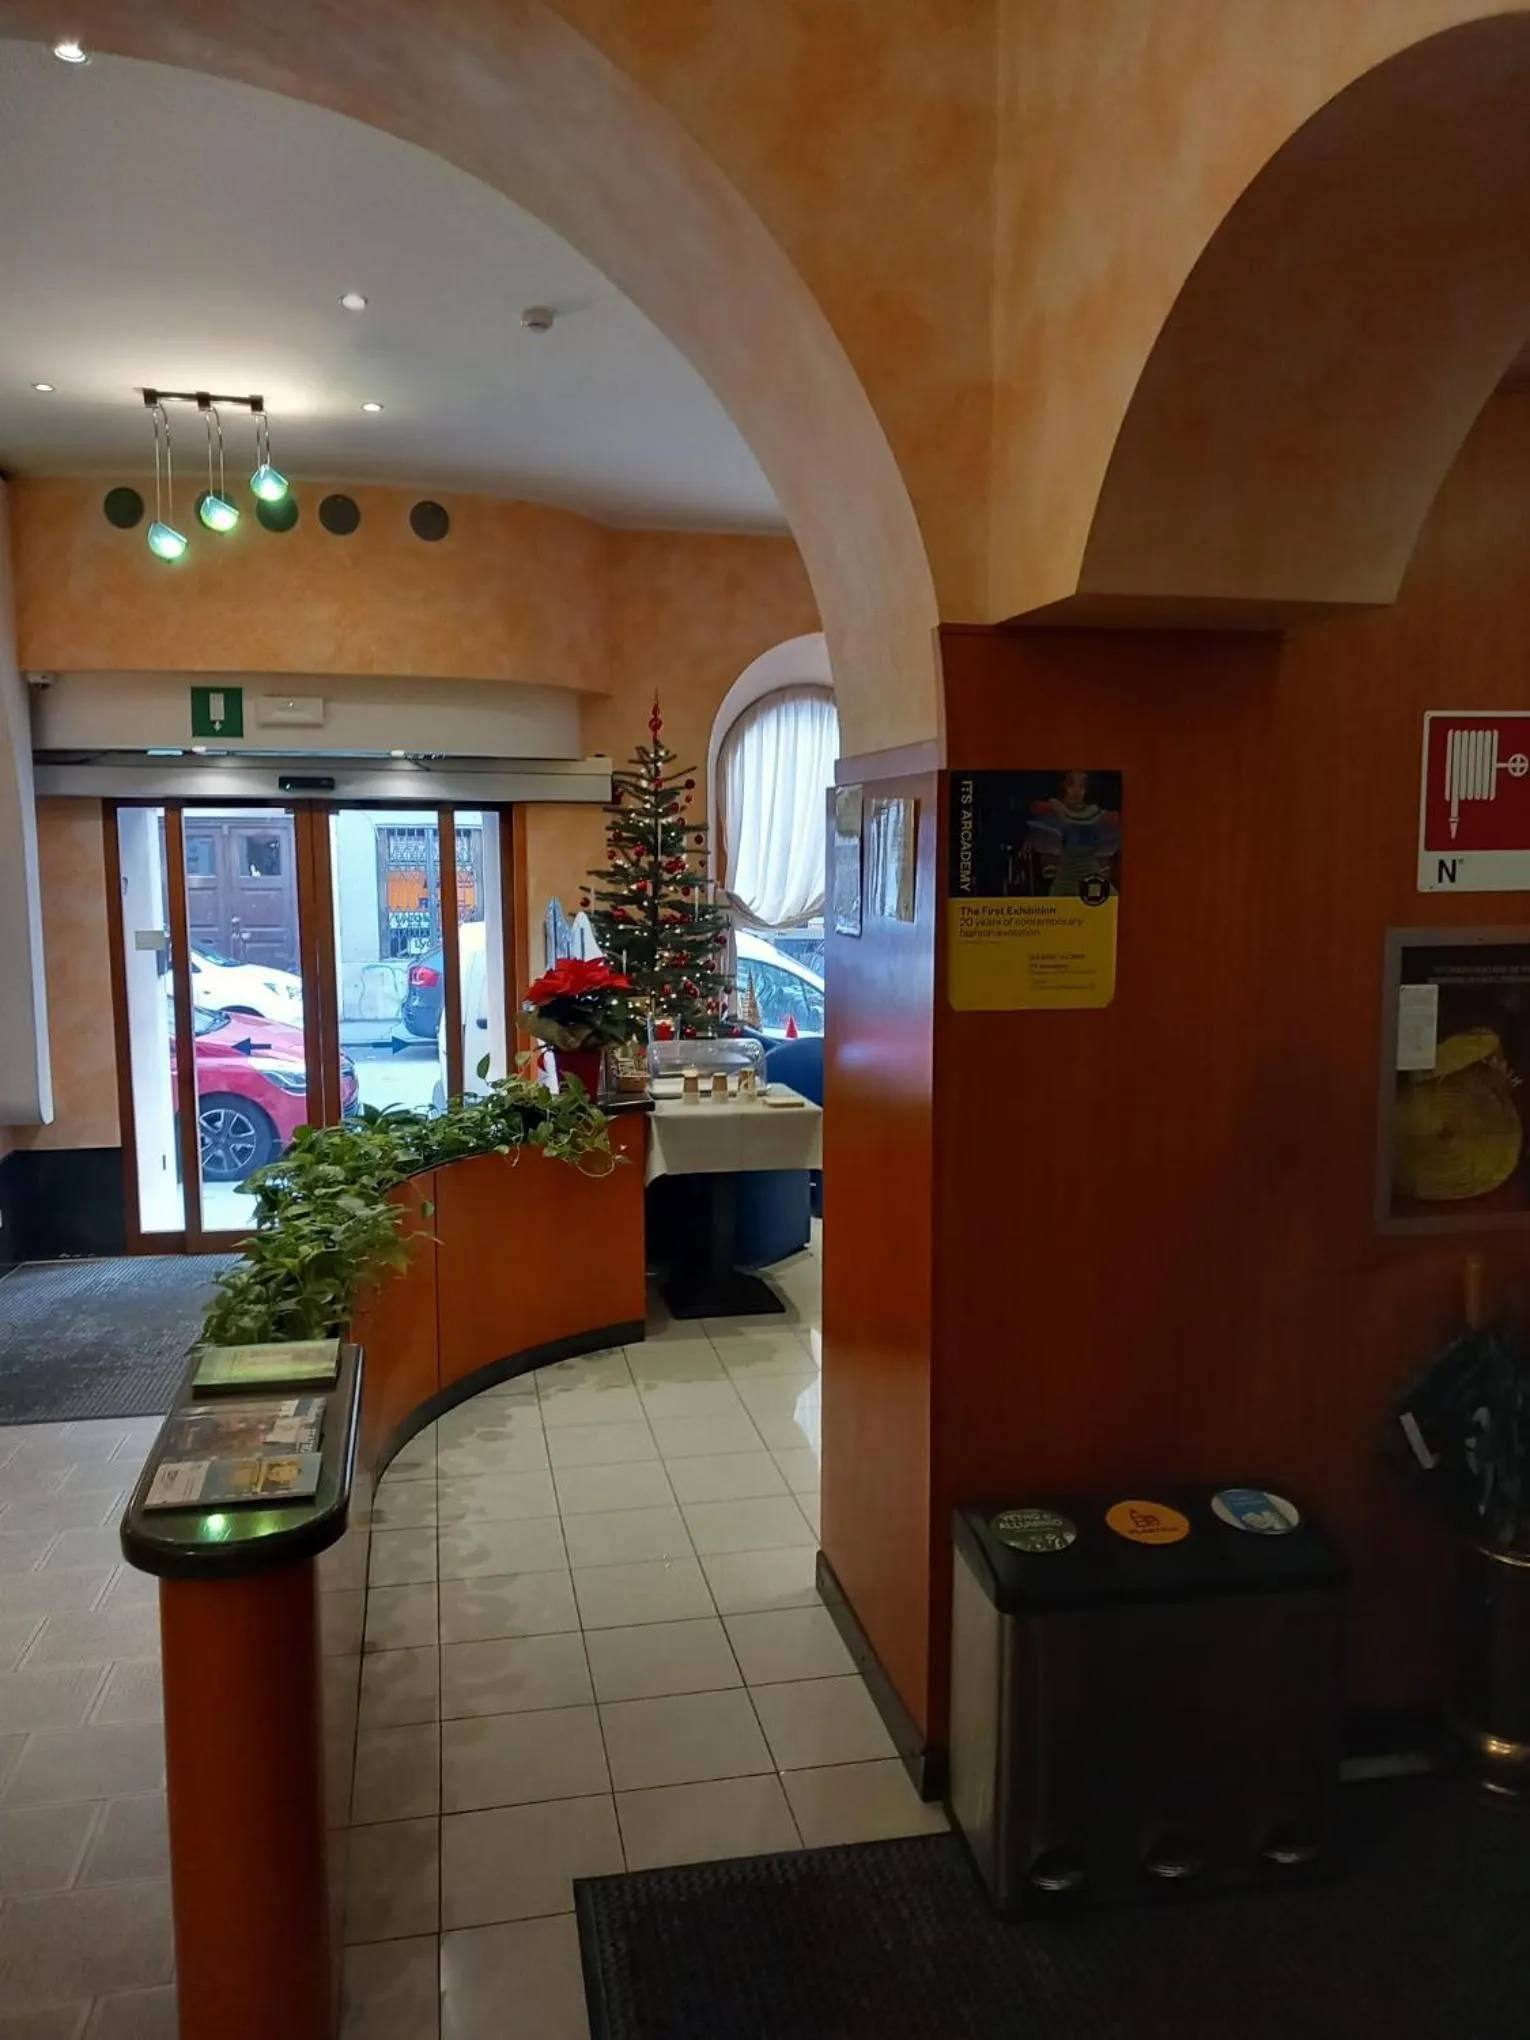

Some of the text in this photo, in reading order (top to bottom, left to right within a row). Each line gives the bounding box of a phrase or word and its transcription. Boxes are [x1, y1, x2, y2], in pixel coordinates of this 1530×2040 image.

[960, 808, 974, 893] ARCADEMY
[960, 904, 1057, 916] The First Exhibition
